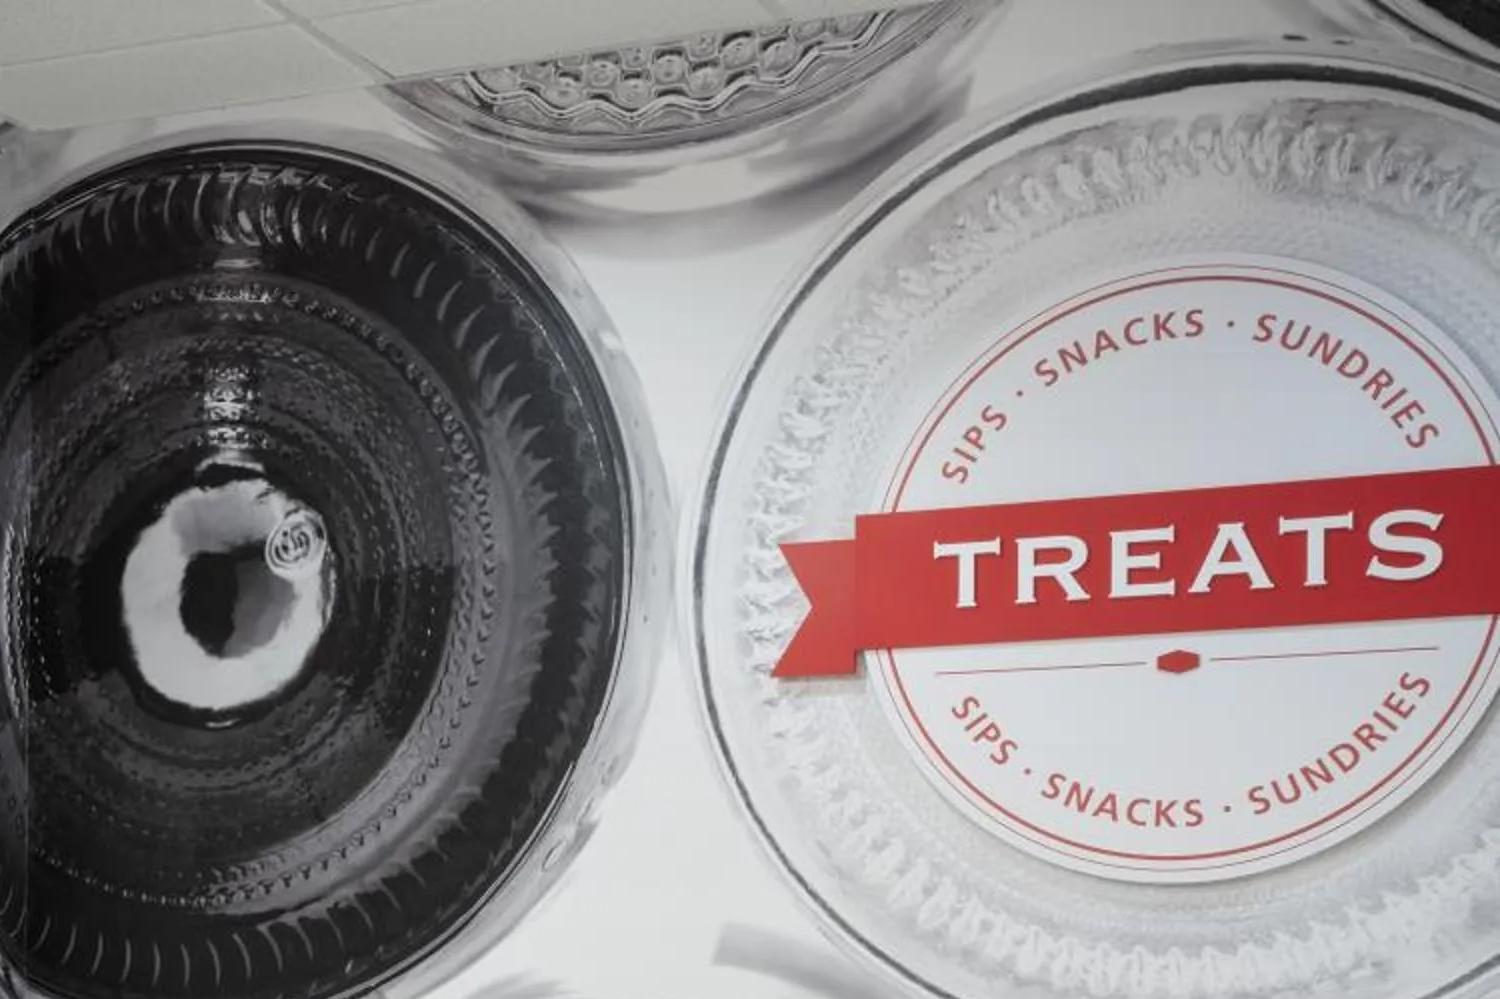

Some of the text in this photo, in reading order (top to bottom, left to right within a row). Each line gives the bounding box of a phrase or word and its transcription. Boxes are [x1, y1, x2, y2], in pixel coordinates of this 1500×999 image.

[941, 309, 1440, 484] SIPS SNACKS SUNDRIES
[933, 508, 1447, 610] TREATS
[951, 671, 1431, 828] SIPS SNACKS SUNDRIES
